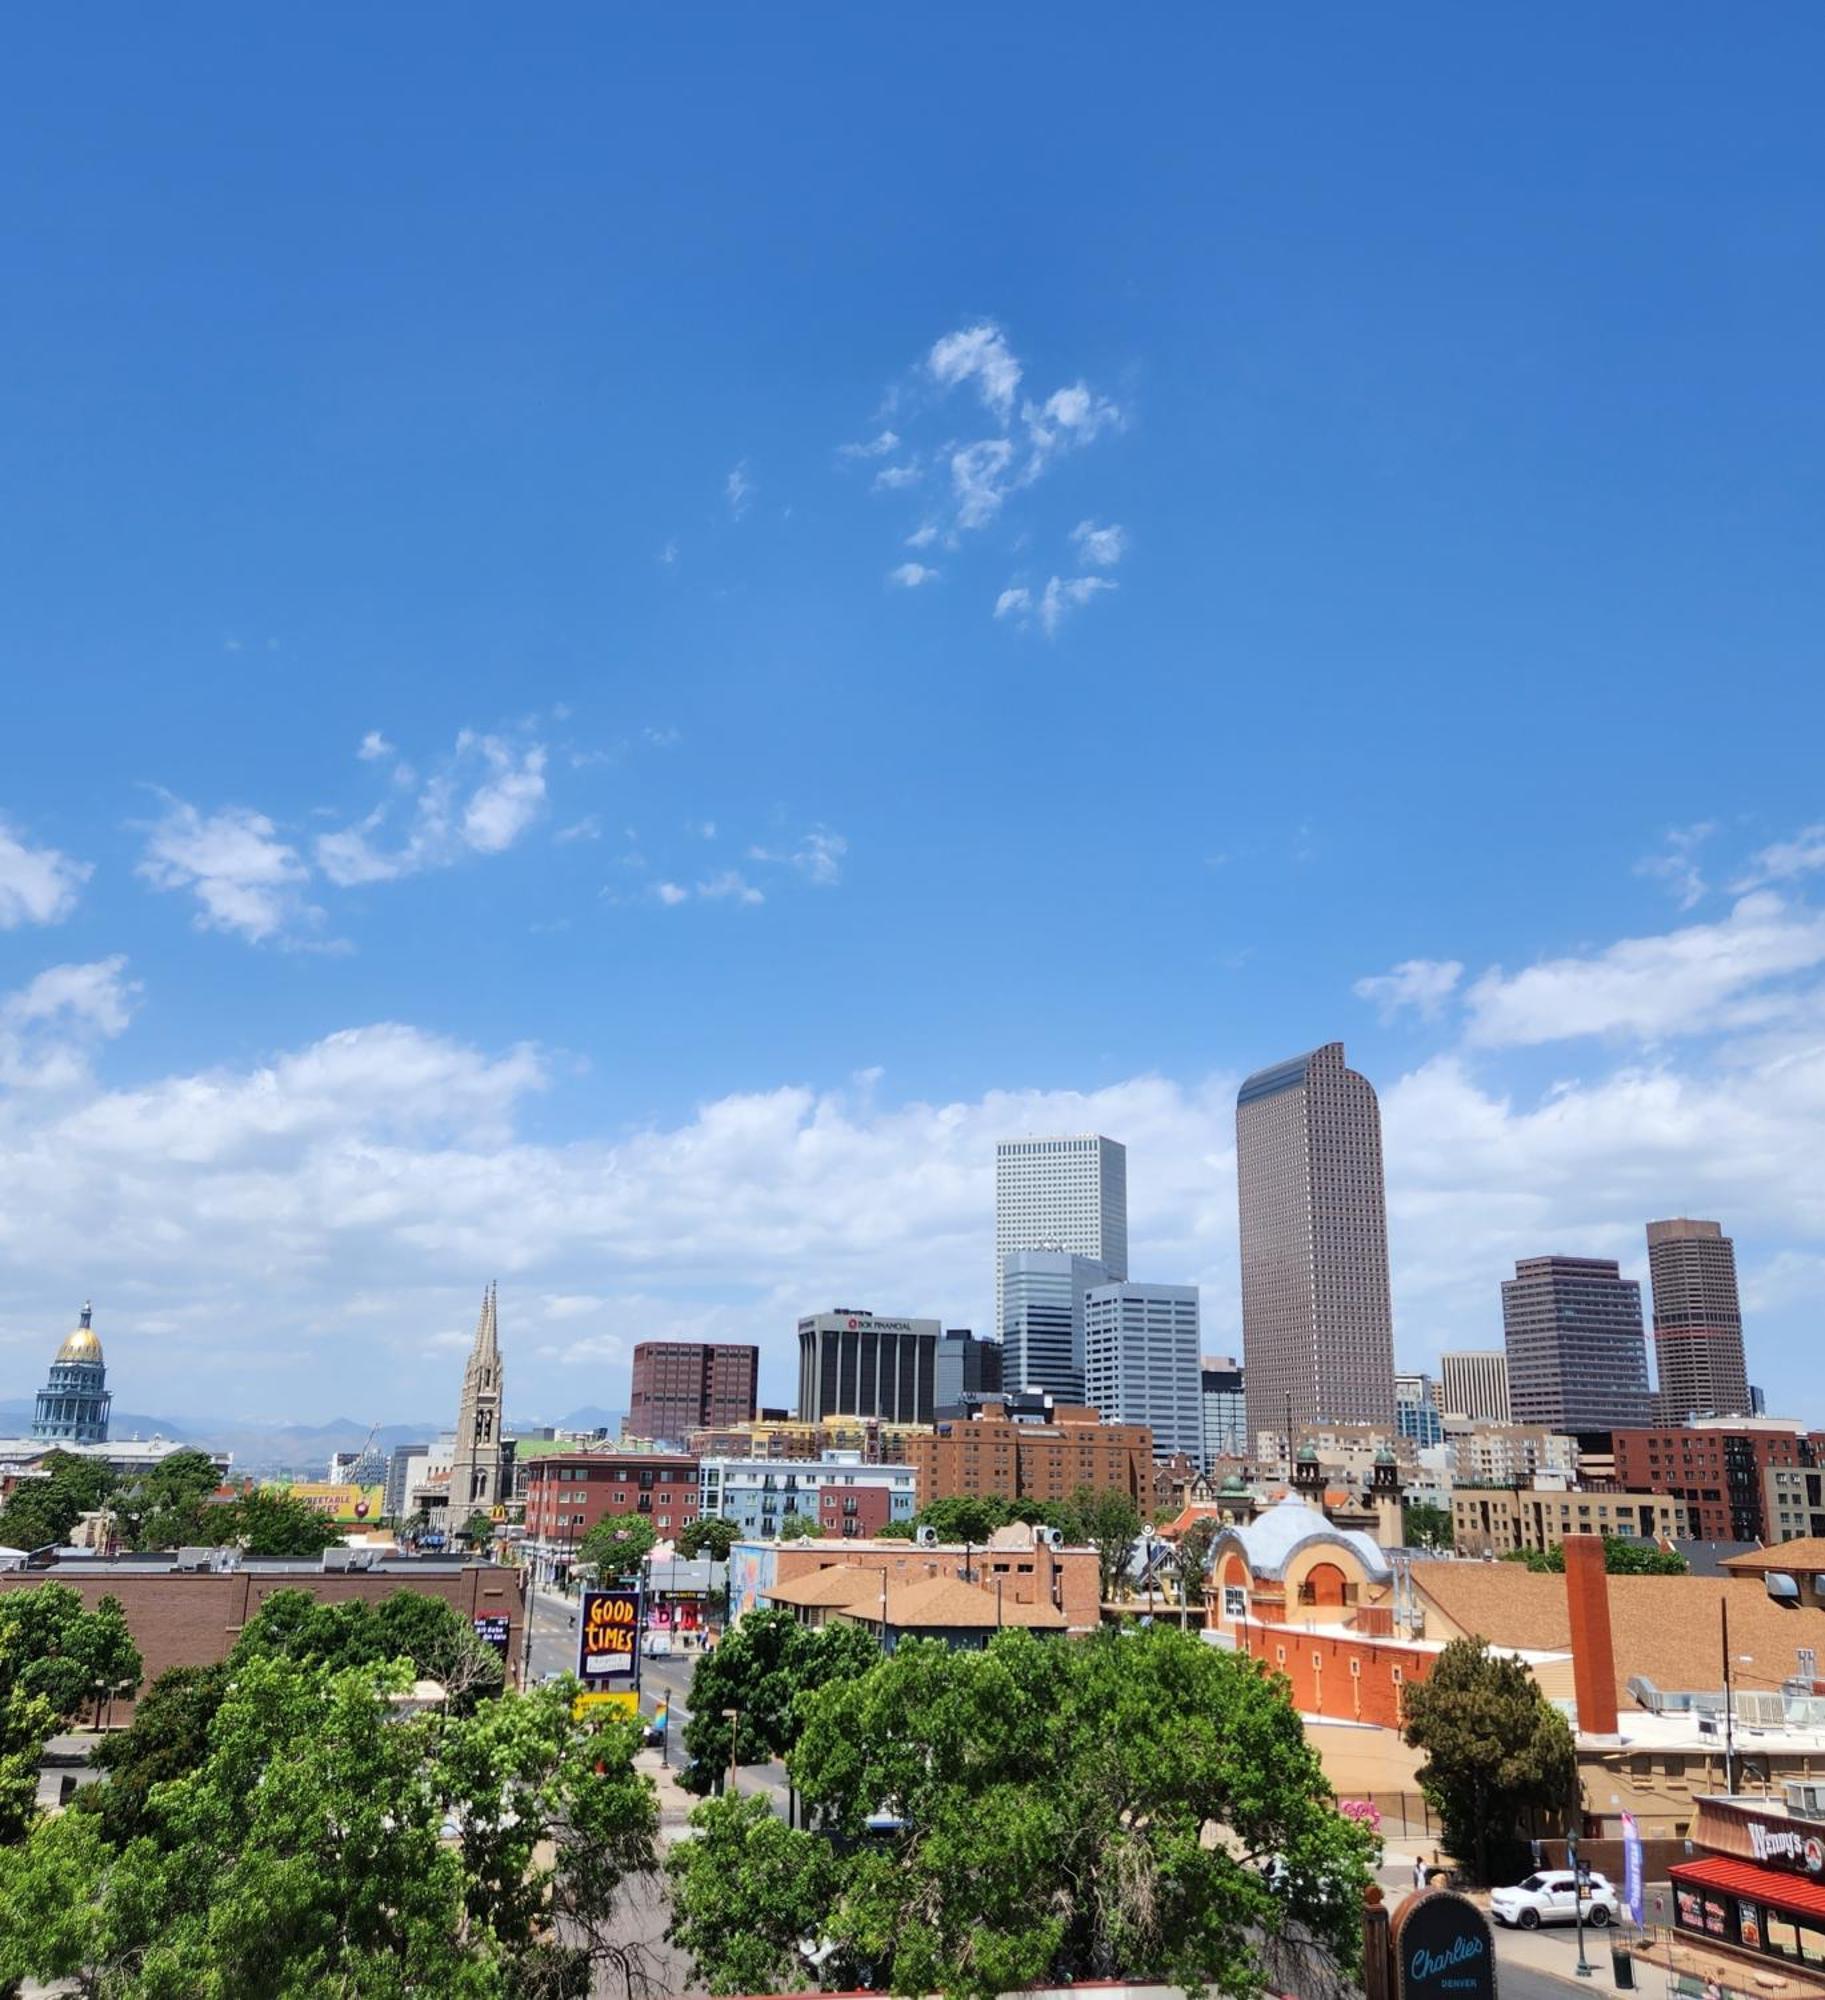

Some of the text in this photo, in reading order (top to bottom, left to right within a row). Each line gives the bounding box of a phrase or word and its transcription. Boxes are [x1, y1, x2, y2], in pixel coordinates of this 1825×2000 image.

[875, 1321, 912, 1331] FINANCIAL
[591, 1598, 634, 1624] GOOD
[1441, 1978, 1477, 1989] DENVER
